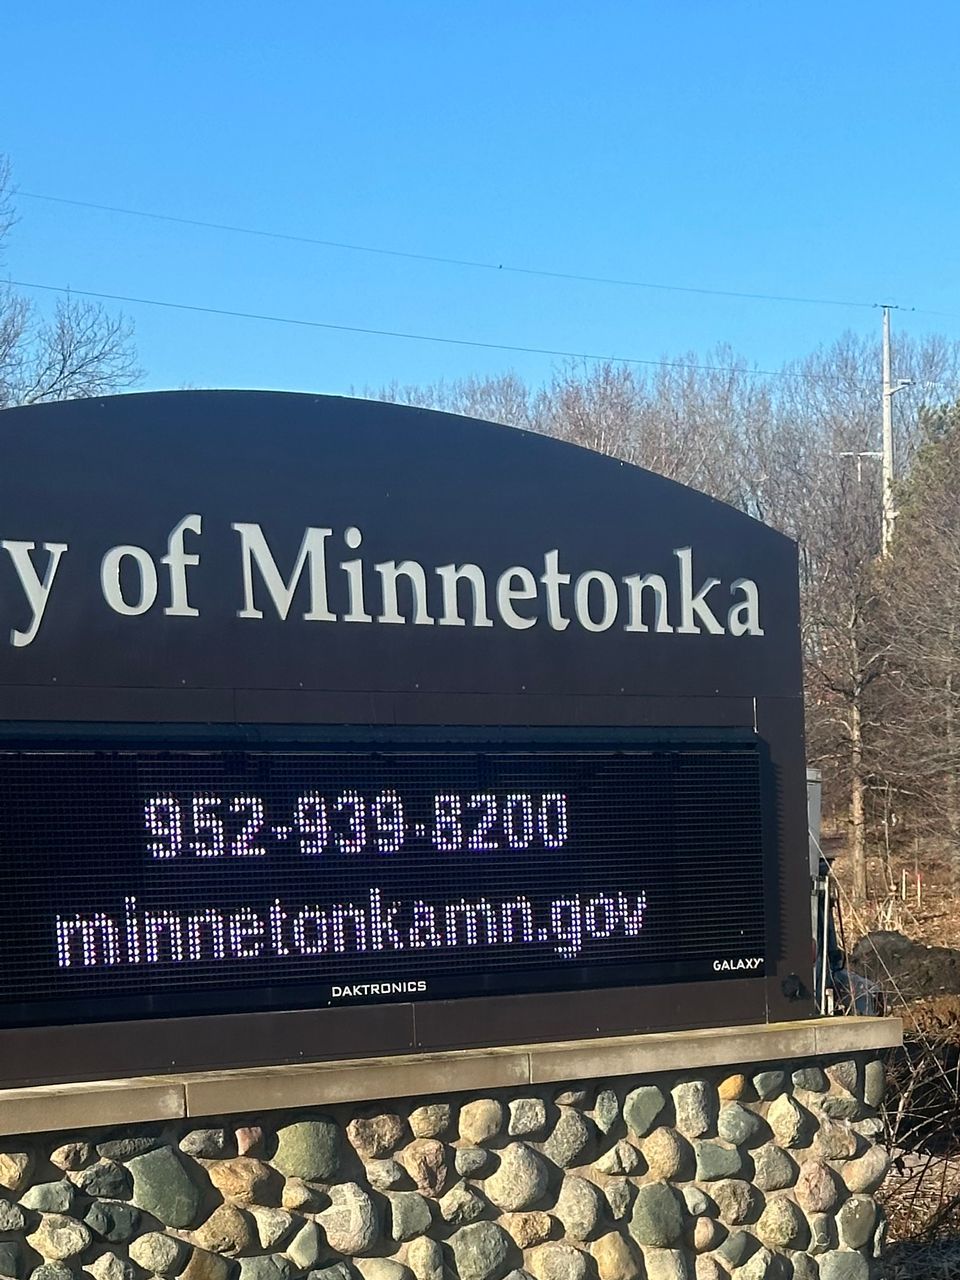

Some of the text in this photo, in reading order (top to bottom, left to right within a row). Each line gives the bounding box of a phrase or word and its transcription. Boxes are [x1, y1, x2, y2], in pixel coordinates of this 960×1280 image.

[1, 514, 764, 647] y of Minnetonka
[145, 791, 567, 857] 952-939-8200
[56, 889, 647, 967] minnetonkamn.gov
[331, 981, 427, 998] DAKTRONICS
